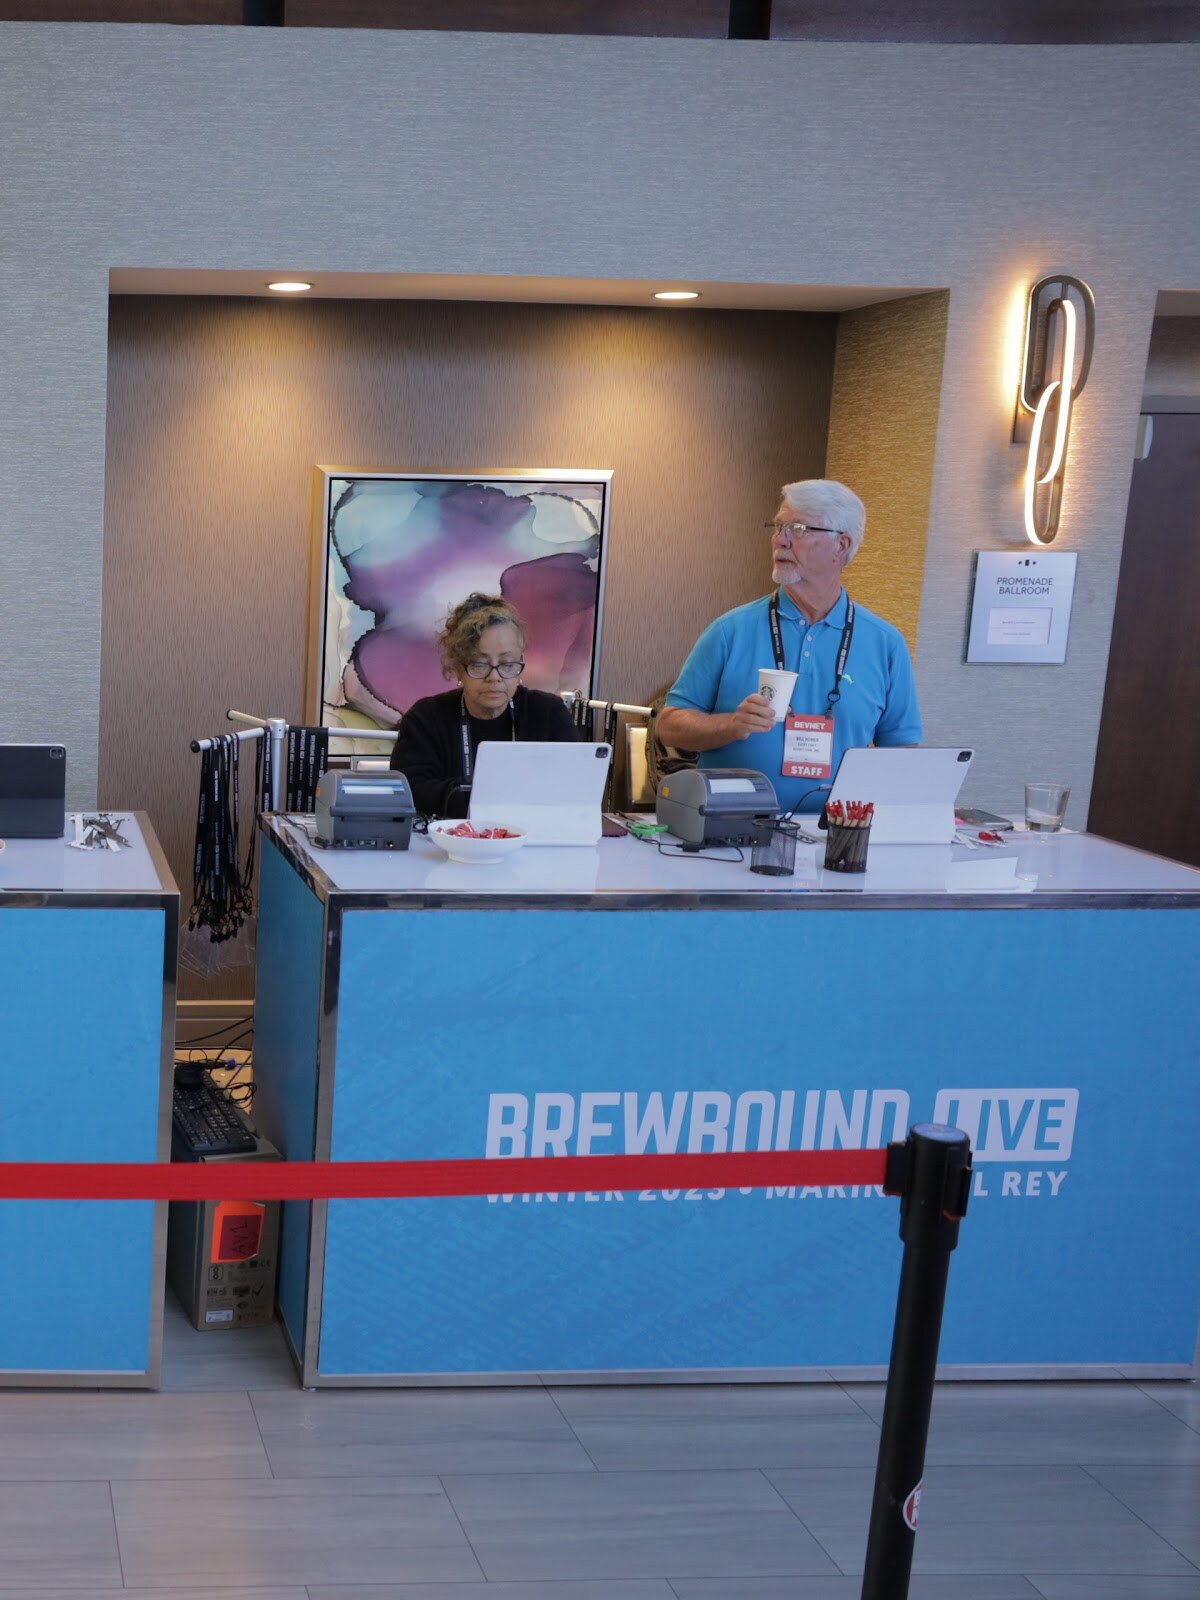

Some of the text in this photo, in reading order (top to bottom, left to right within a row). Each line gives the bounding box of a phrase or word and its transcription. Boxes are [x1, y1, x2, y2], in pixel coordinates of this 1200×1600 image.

[996, 576, 1054, 586] PROMENADE
[998, 586, 1051, 595] BALLROOM
[793, 721, 826, 731] BEVNET
[790, 765, 823, 777] STAFF
[1001, 1171, 1068, 1196] REY
